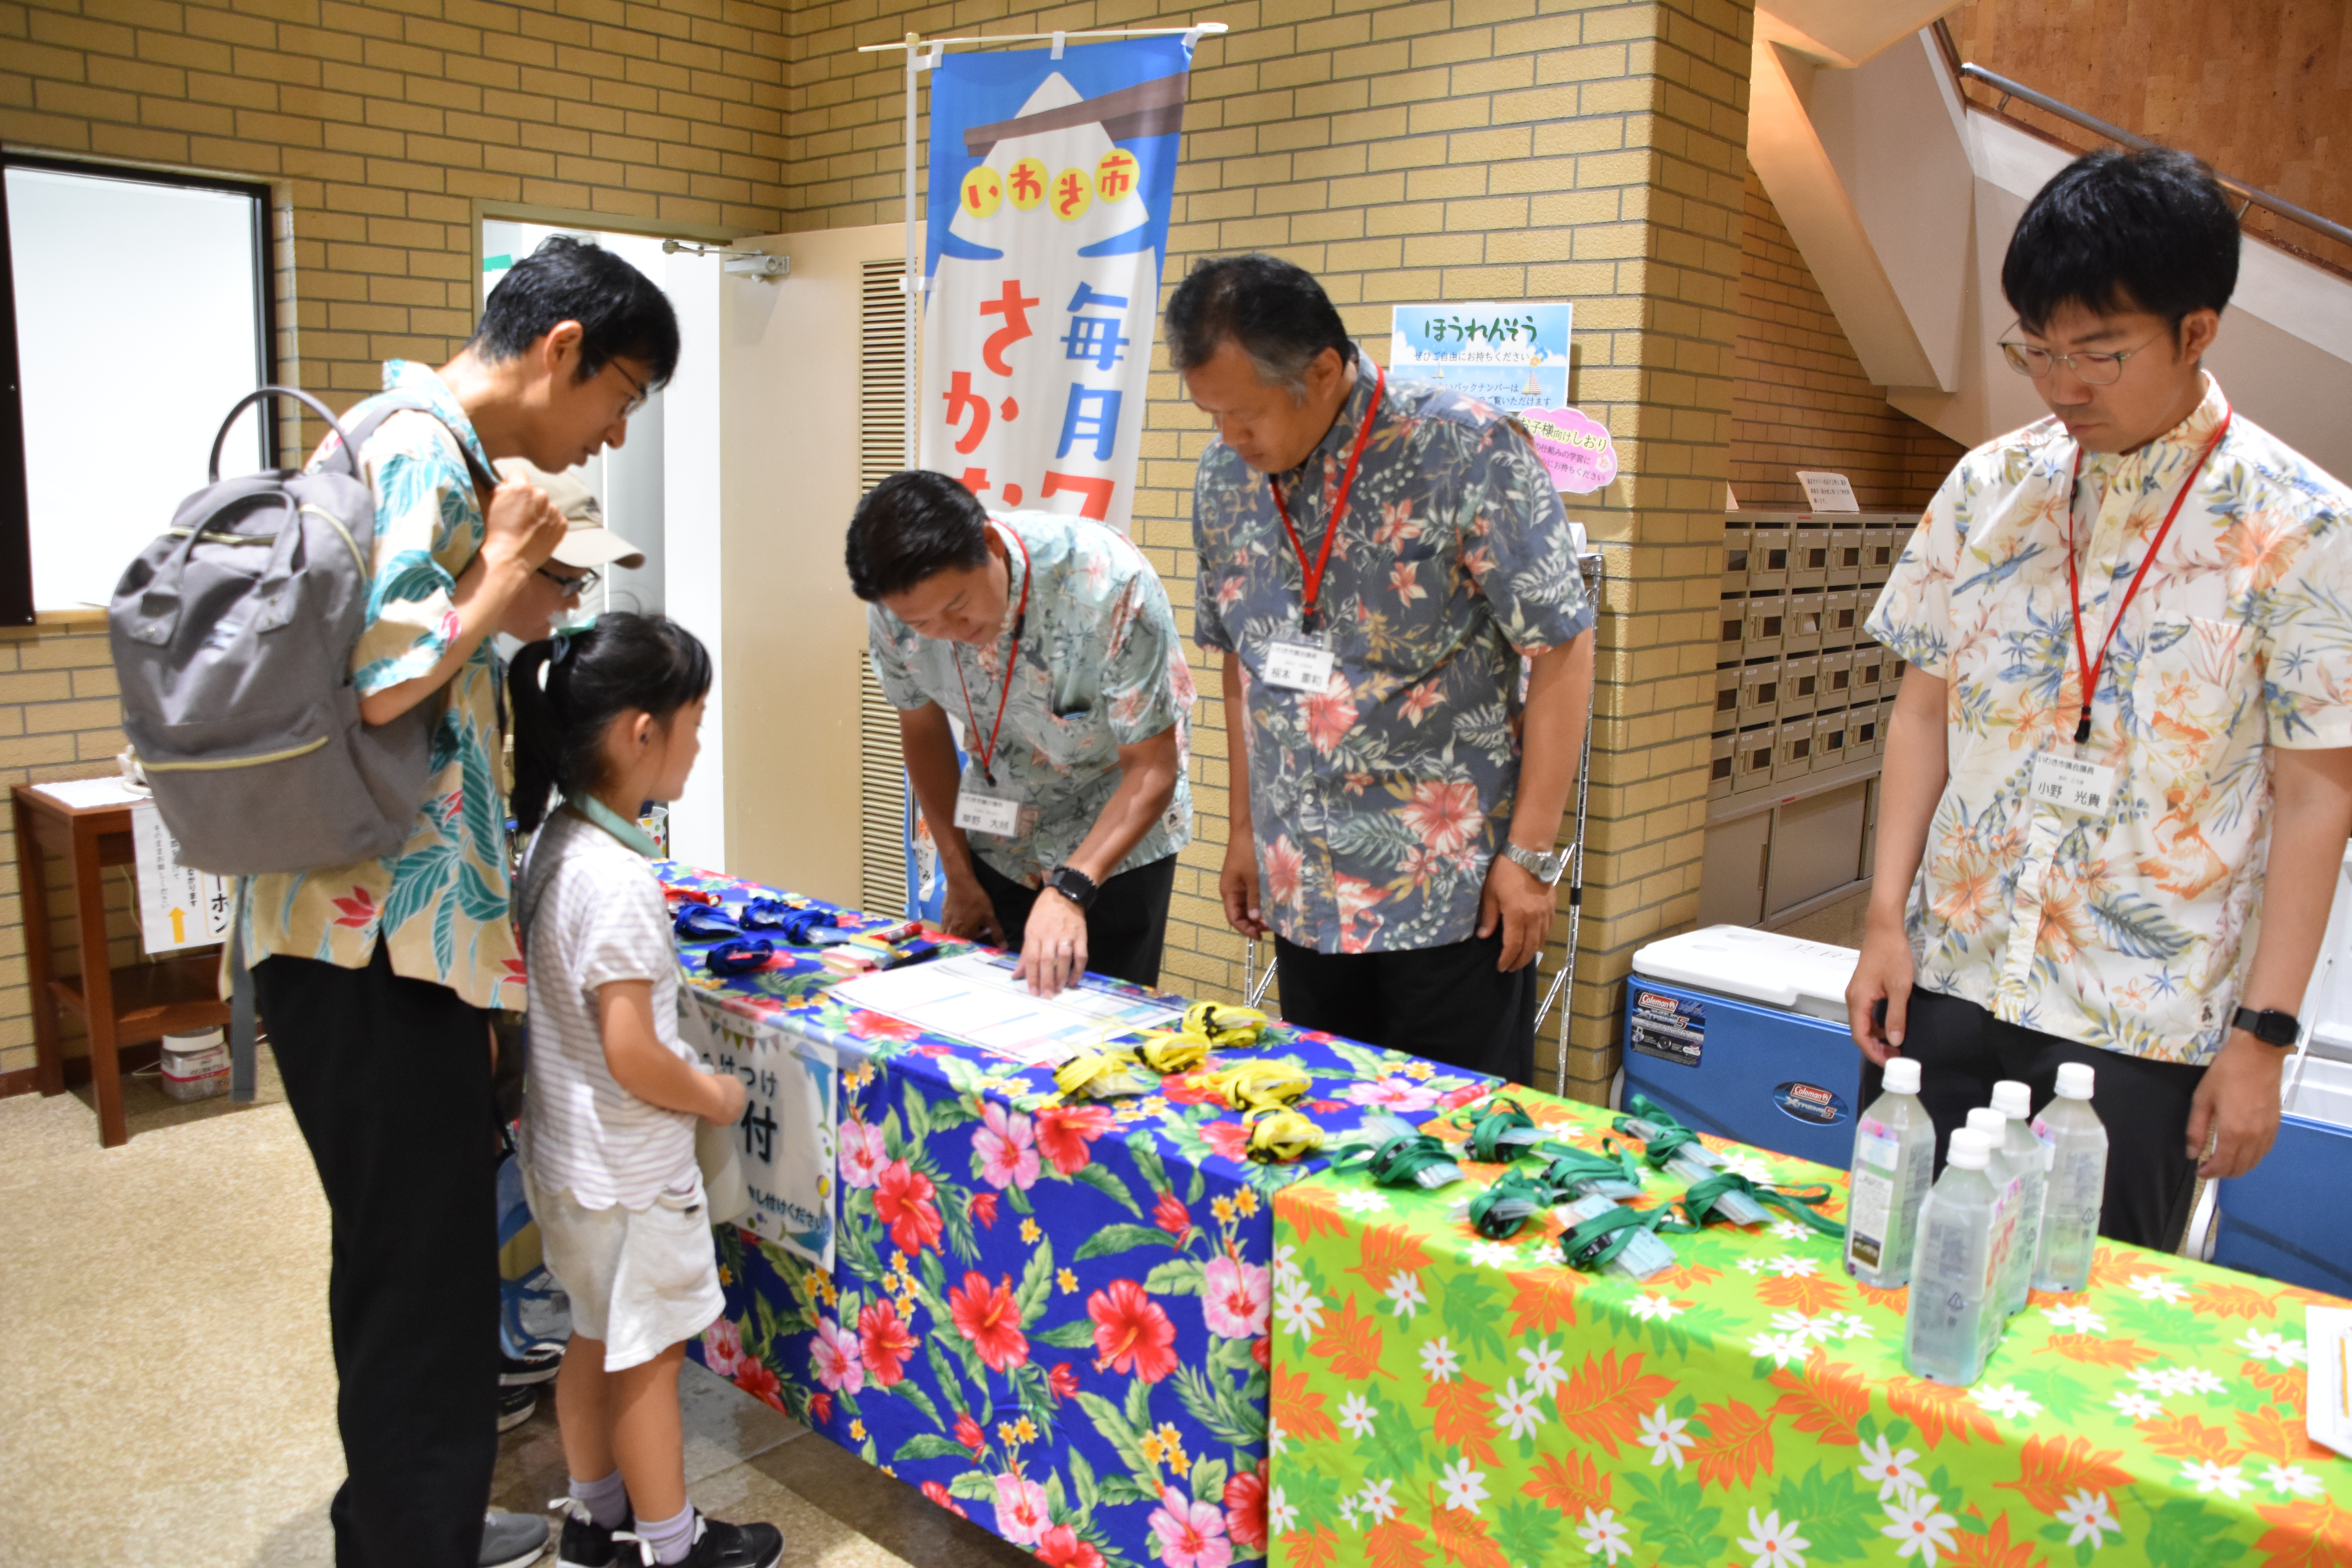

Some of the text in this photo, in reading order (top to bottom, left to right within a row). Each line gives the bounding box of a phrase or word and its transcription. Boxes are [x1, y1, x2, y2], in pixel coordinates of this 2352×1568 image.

[967, 154, 1133, 216] いわき市
[1414, 351, 1530, 362] ぜひご自由にお持ちください
[1439, 383, 1519, 393] いバックナンバーは
[1521, 417, 1607, 452] お子様向けしおり
[2038, 756, 2094, 775] いわき市議会議員
[2038, 782, 2100, 808] 小野 光貴
[1642, 994, 1669, 1008] Coleman
[1794, 1085, 1822, 1100] Coleman
[741, 1099, 778, 1163] 付
